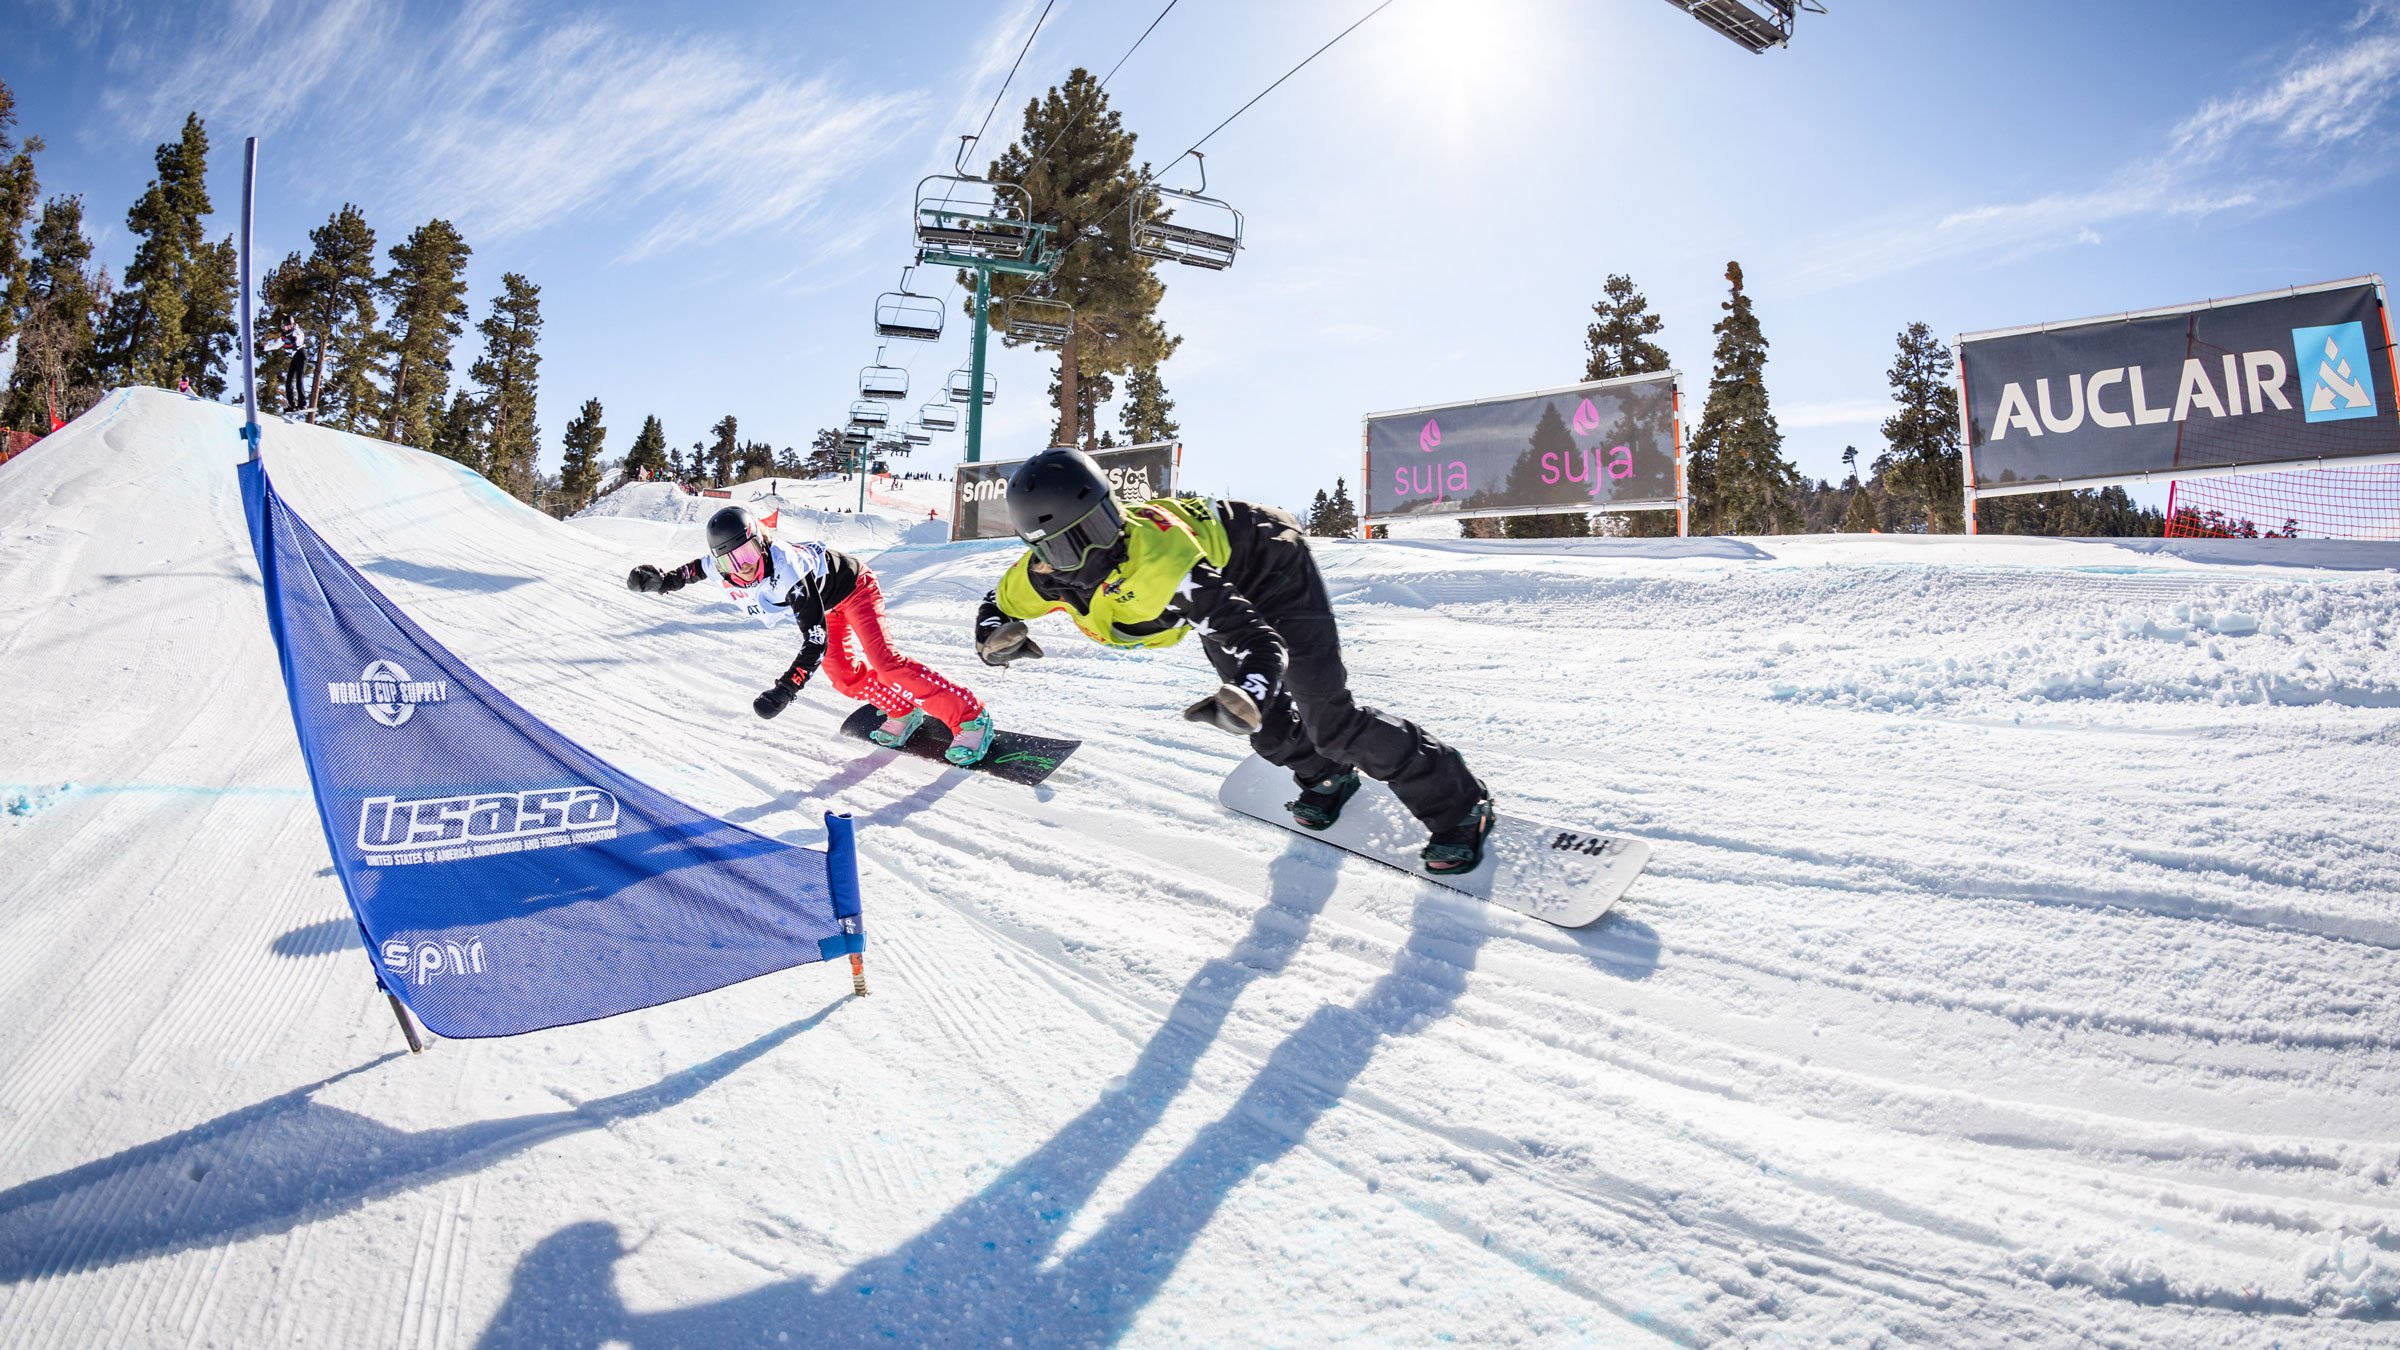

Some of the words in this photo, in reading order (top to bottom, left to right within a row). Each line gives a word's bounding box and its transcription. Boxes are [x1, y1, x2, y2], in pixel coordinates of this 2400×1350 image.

[1990, 350, 2293, 441] AUCLAIR
[1394, 460, 1469, 506] suja
[1541, 445, 1634, 496] suja
[328, 681, 372, 704] WORLD
[374, 681, 397, 703] CUP
[400, 681, 447, 702] SUPPLY
[890, 682, 926, 706] USA
[365, 855, 393, 866] UNITED
[393, 853, 423, 865] STATES
[424, 851, 435, 863] OF
[437, 846, 474, 862] AMERICA
[474, 840, 523, 856] SNOWBOARD
[523, 838, 540, 851] AND
[541, 834, 571, 848] FREESKI
[572, 828, 617, 844] ASSOCIATION
